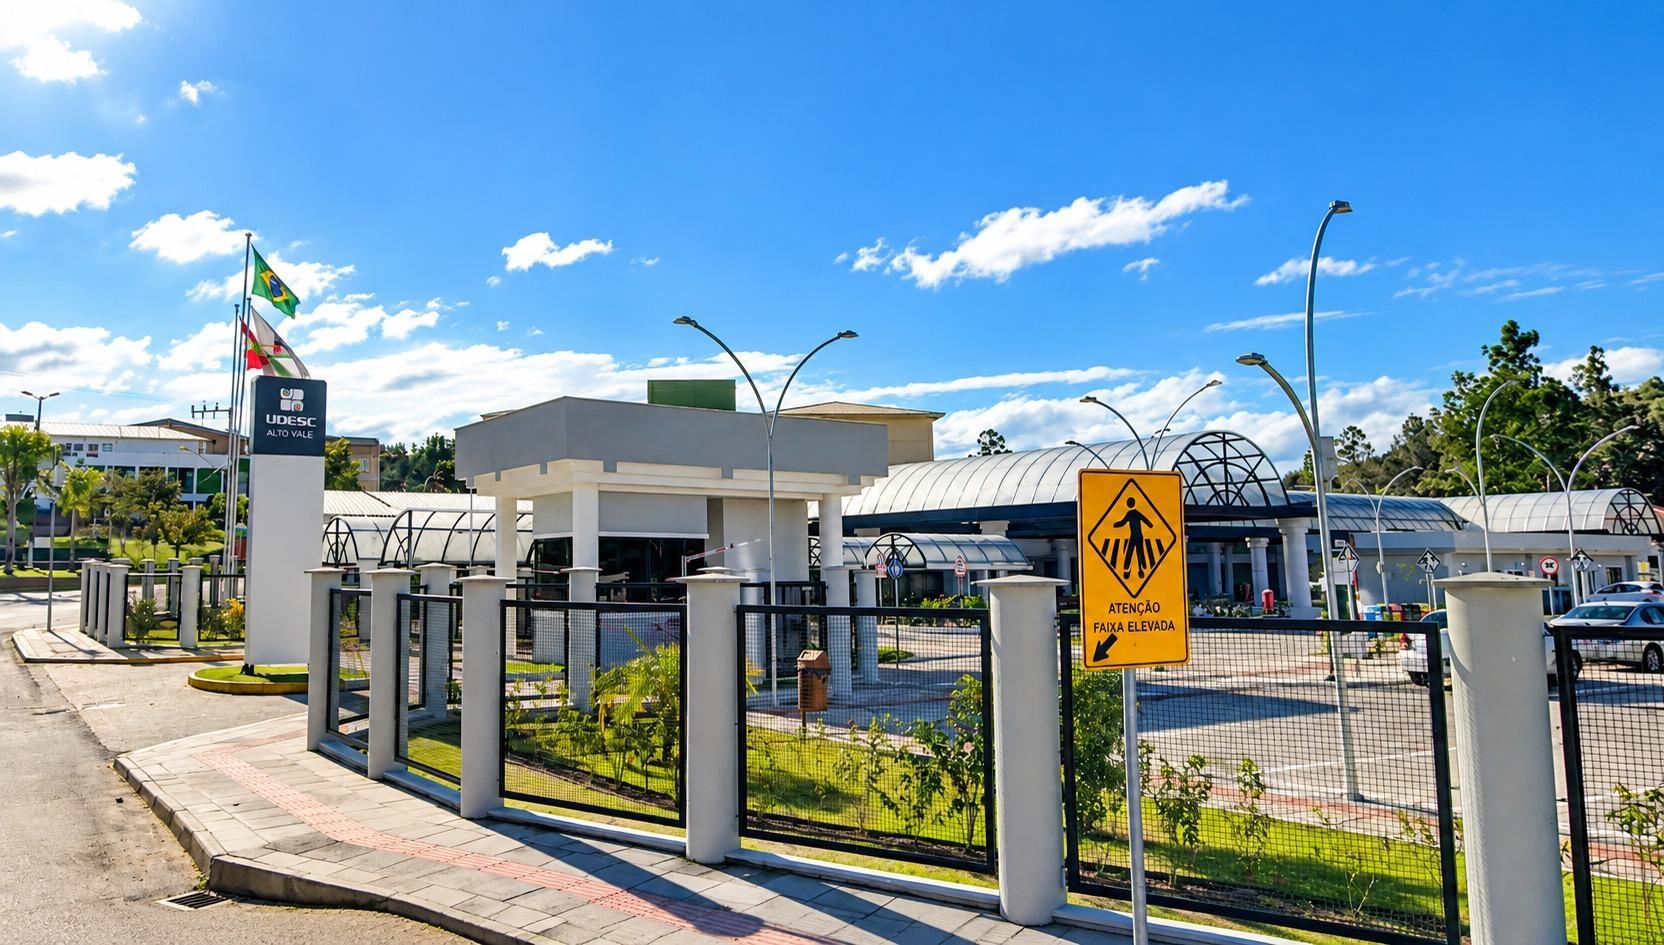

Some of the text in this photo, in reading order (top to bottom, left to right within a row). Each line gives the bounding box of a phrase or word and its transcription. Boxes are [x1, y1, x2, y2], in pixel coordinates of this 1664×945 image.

[266, 414, 316, 427] UDESC
[266, 429, 314, 439] ALTO VALE
[1108, 600, 1161, 616] ATENÇÃO
[1093, 620, 1176, 633] FAIXA ELEVADA
